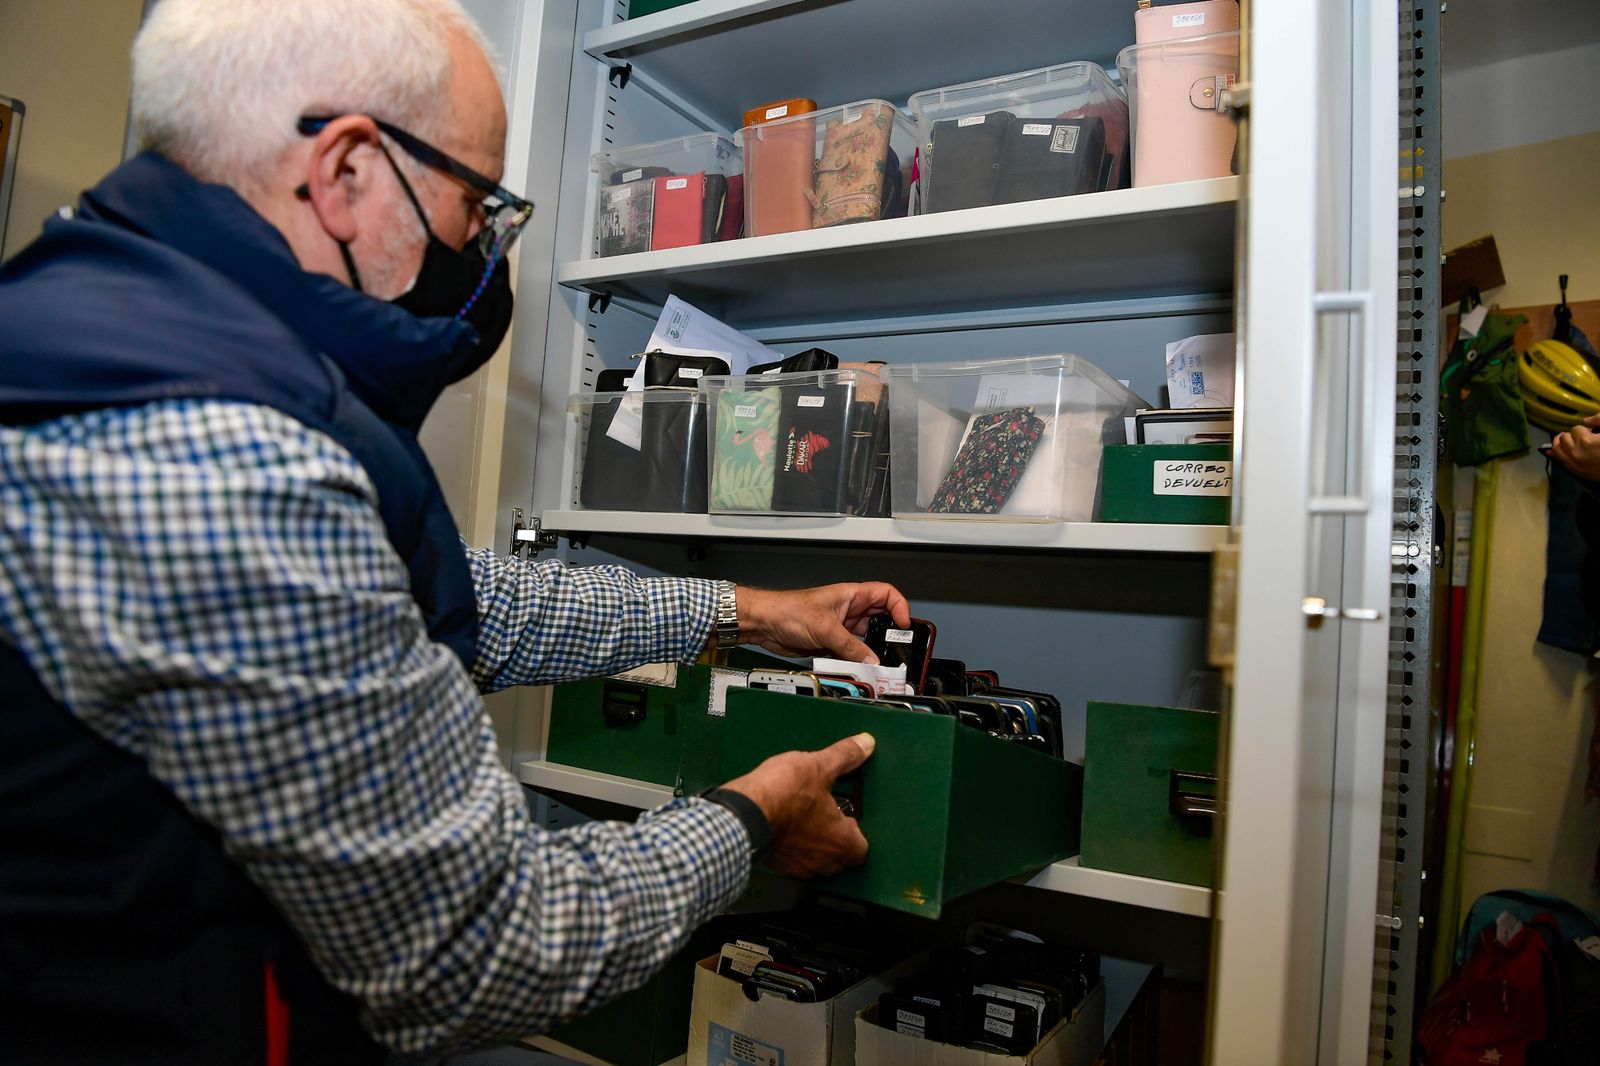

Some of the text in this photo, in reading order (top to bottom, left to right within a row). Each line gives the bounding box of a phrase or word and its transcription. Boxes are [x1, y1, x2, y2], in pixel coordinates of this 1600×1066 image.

[783, 440, 794, 471] Haulotte
[797, 440, 808, 465] DAKAR
[1165, 463, 1226, 474] CORREO
[1164, 477, 1232, 488] DEVUELT
